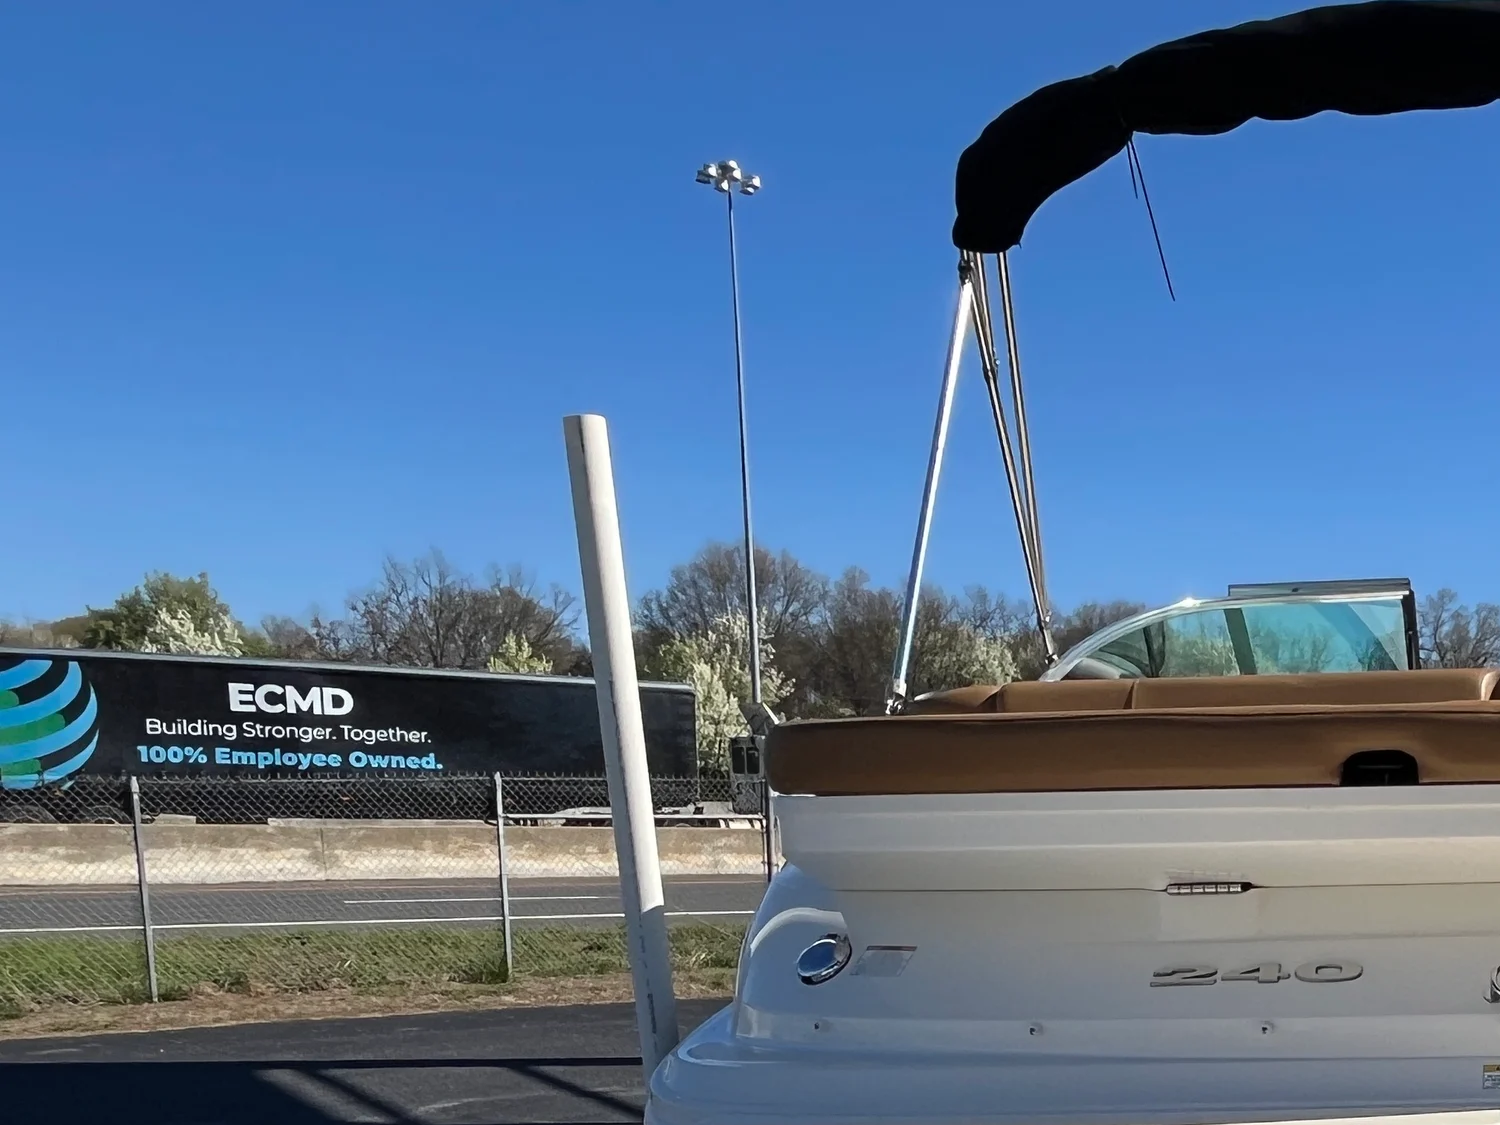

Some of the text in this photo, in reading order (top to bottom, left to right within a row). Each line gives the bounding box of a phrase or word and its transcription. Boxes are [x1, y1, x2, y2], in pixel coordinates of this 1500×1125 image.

[228, 682, 354, 716] ECMD
[145, 718, 432, 745] Building Stronger. Together.
[136, 745, 444, 771] 100% Employee Owned.
[1150, 964, 1364, 988] 240
